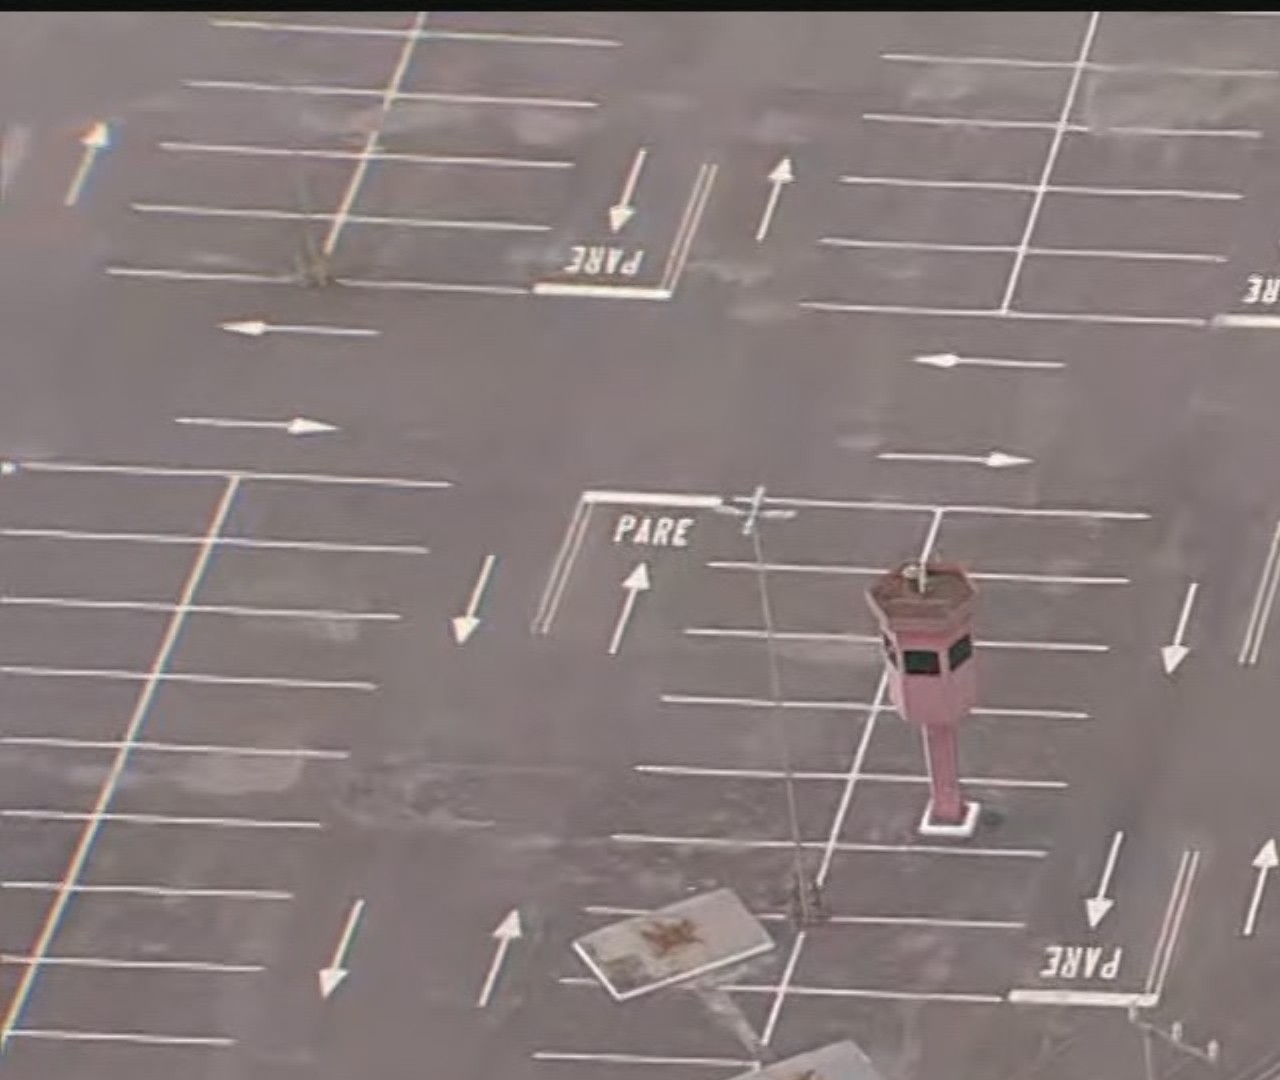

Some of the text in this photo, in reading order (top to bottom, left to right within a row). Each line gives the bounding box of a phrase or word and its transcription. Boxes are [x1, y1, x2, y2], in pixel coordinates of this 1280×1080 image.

[563, 246, 644, 274] PARE
[613, 515, 694, 546] PARE
[1040, 946, 1122, 978] PARE
